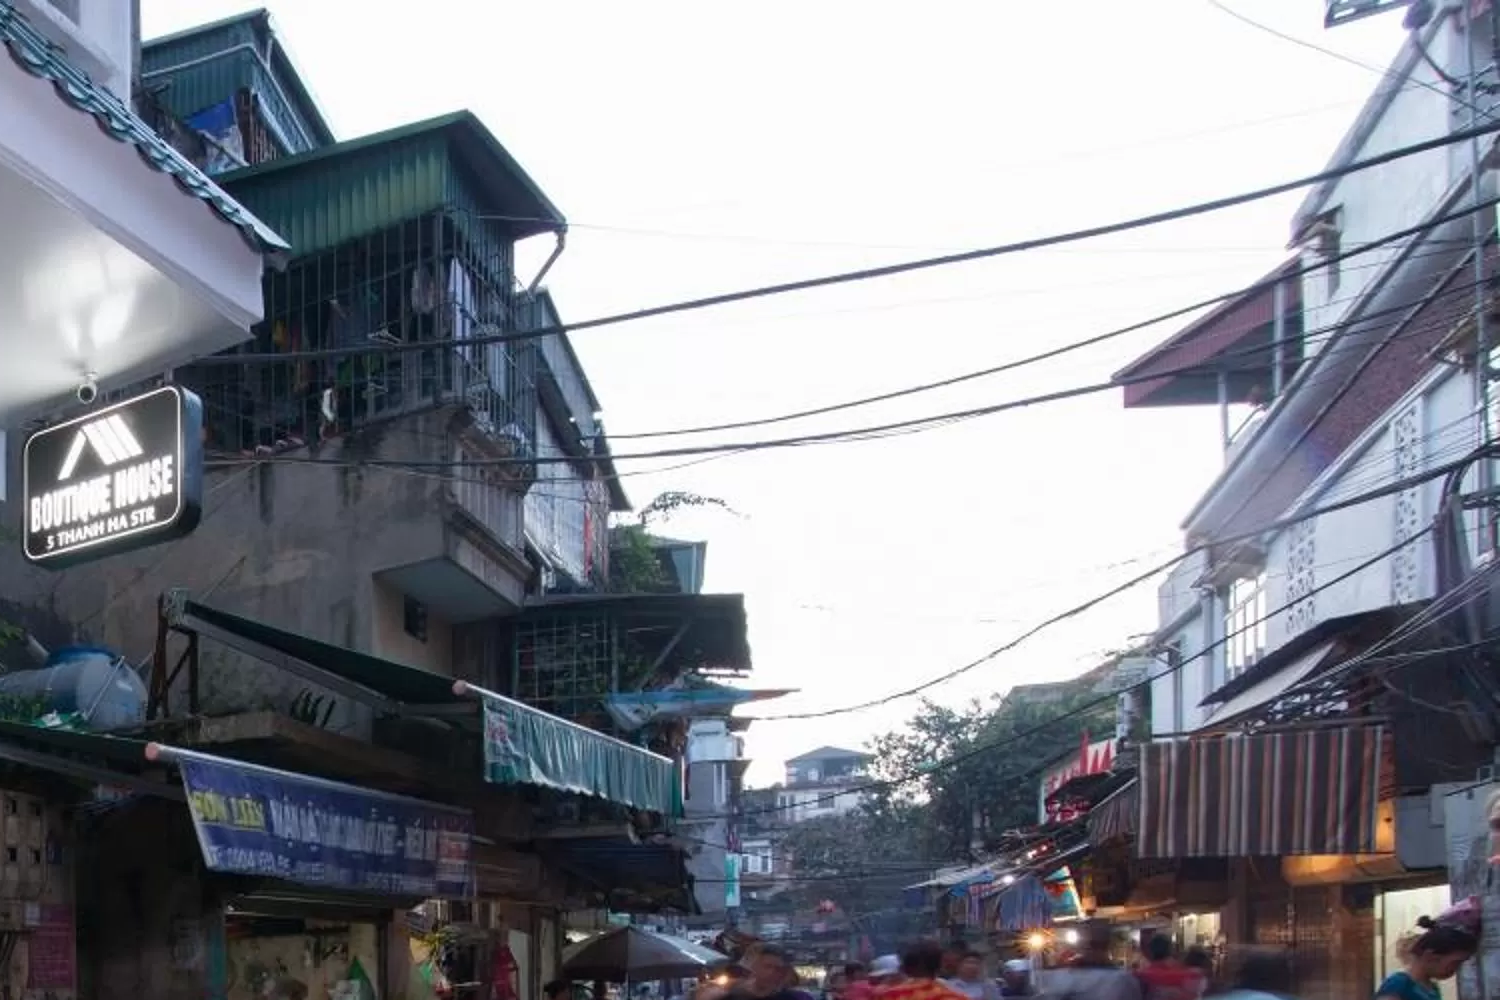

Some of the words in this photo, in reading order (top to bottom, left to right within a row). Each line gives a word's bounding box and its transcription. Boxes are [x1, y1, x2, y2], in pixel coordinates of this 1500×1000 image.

[31, 475, 111, 532] BOUTIQUE
[114, 455, 173, 508] HOUSE
[58, 520, 105, 546] THANH
[107, 514, 128, 533] HA
